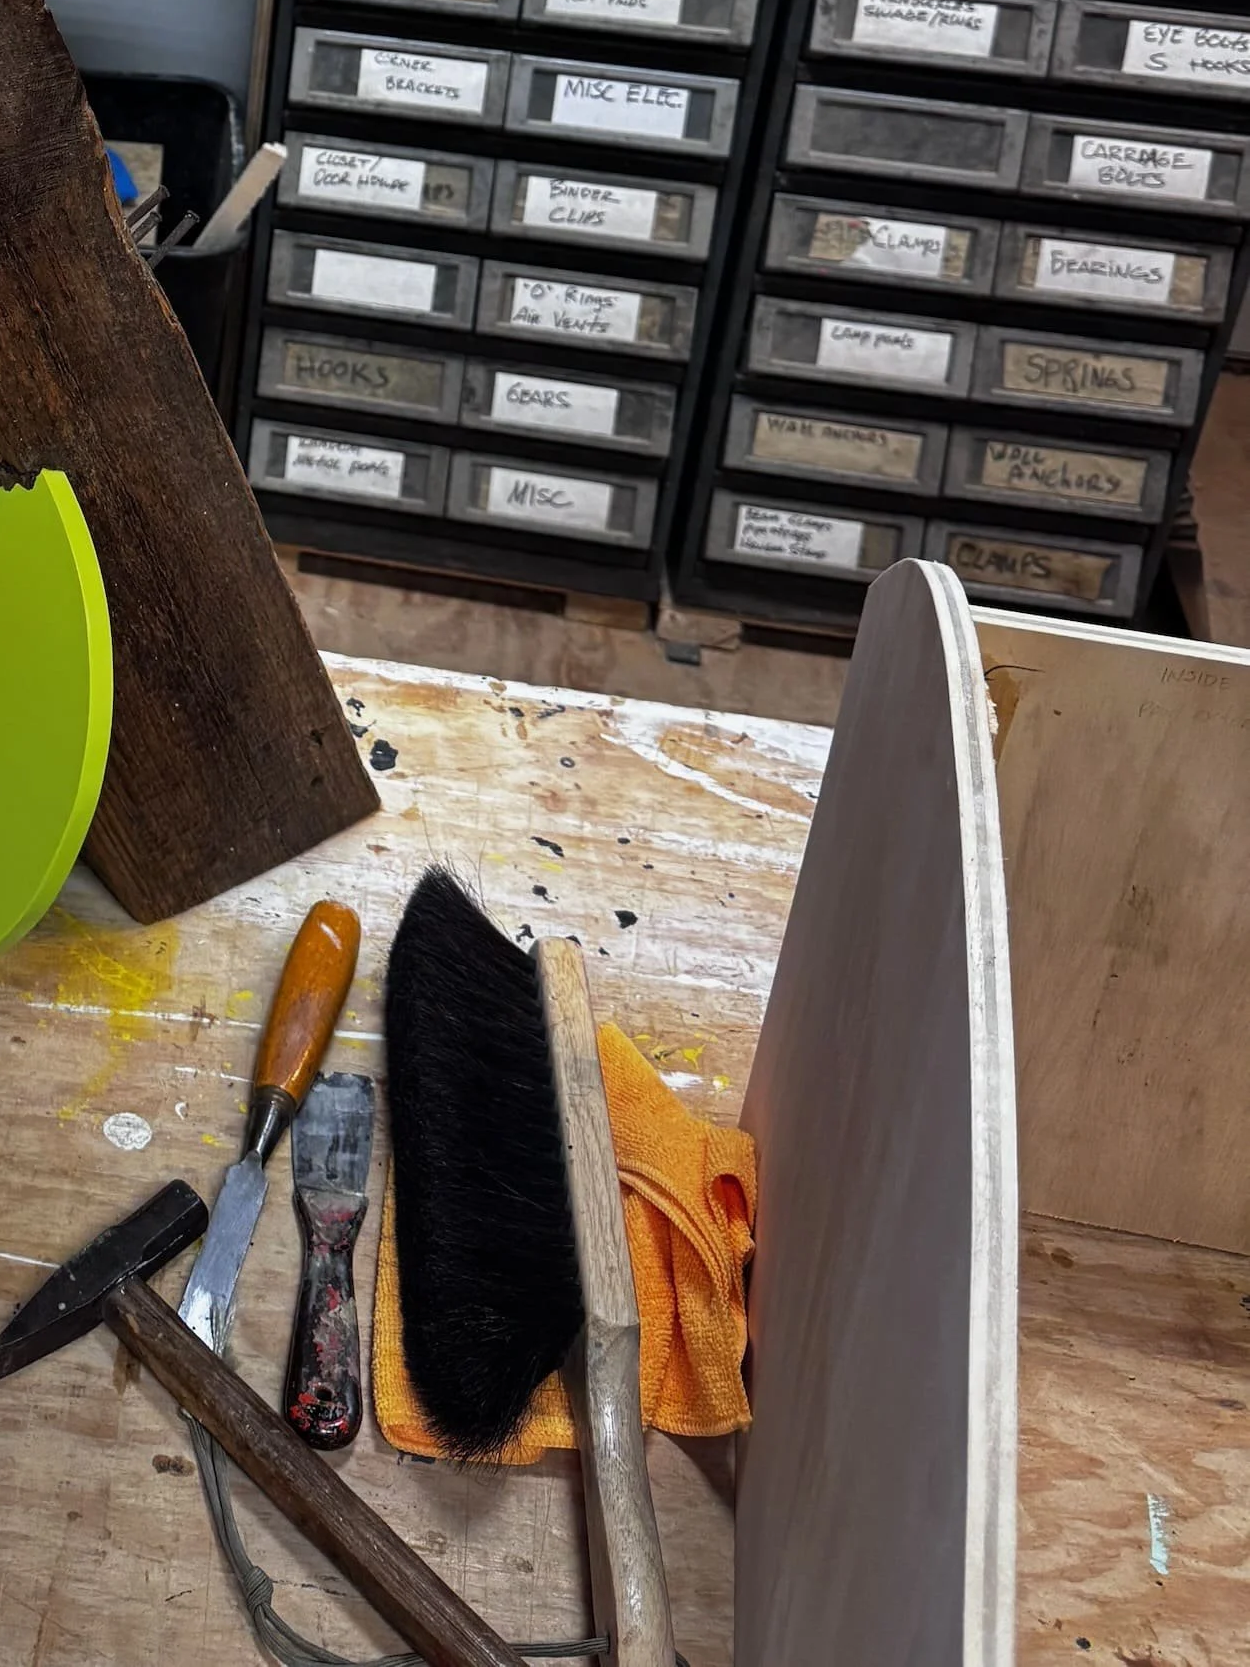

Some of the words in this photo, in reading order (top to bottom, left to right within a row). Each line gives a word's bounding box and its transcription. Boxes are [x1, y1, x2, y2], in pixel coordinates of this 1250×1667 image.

[1143, 22, 1184, 46] EYE
[1144, 52, 1168, 72] S
[385, 75, 461, 100] BRACKETS
[563, 76, 616, 102] MISC
[549, 179, 622, 204] BINDER
[548, 205, 607, 226] CLIPS
[295, 354, 391, 389] HOOKS
[1024, 353, 1136, 393] SPRINGS
[506, 381, 572, 410] GEARS
[506, 479, 574, 509] MISC
